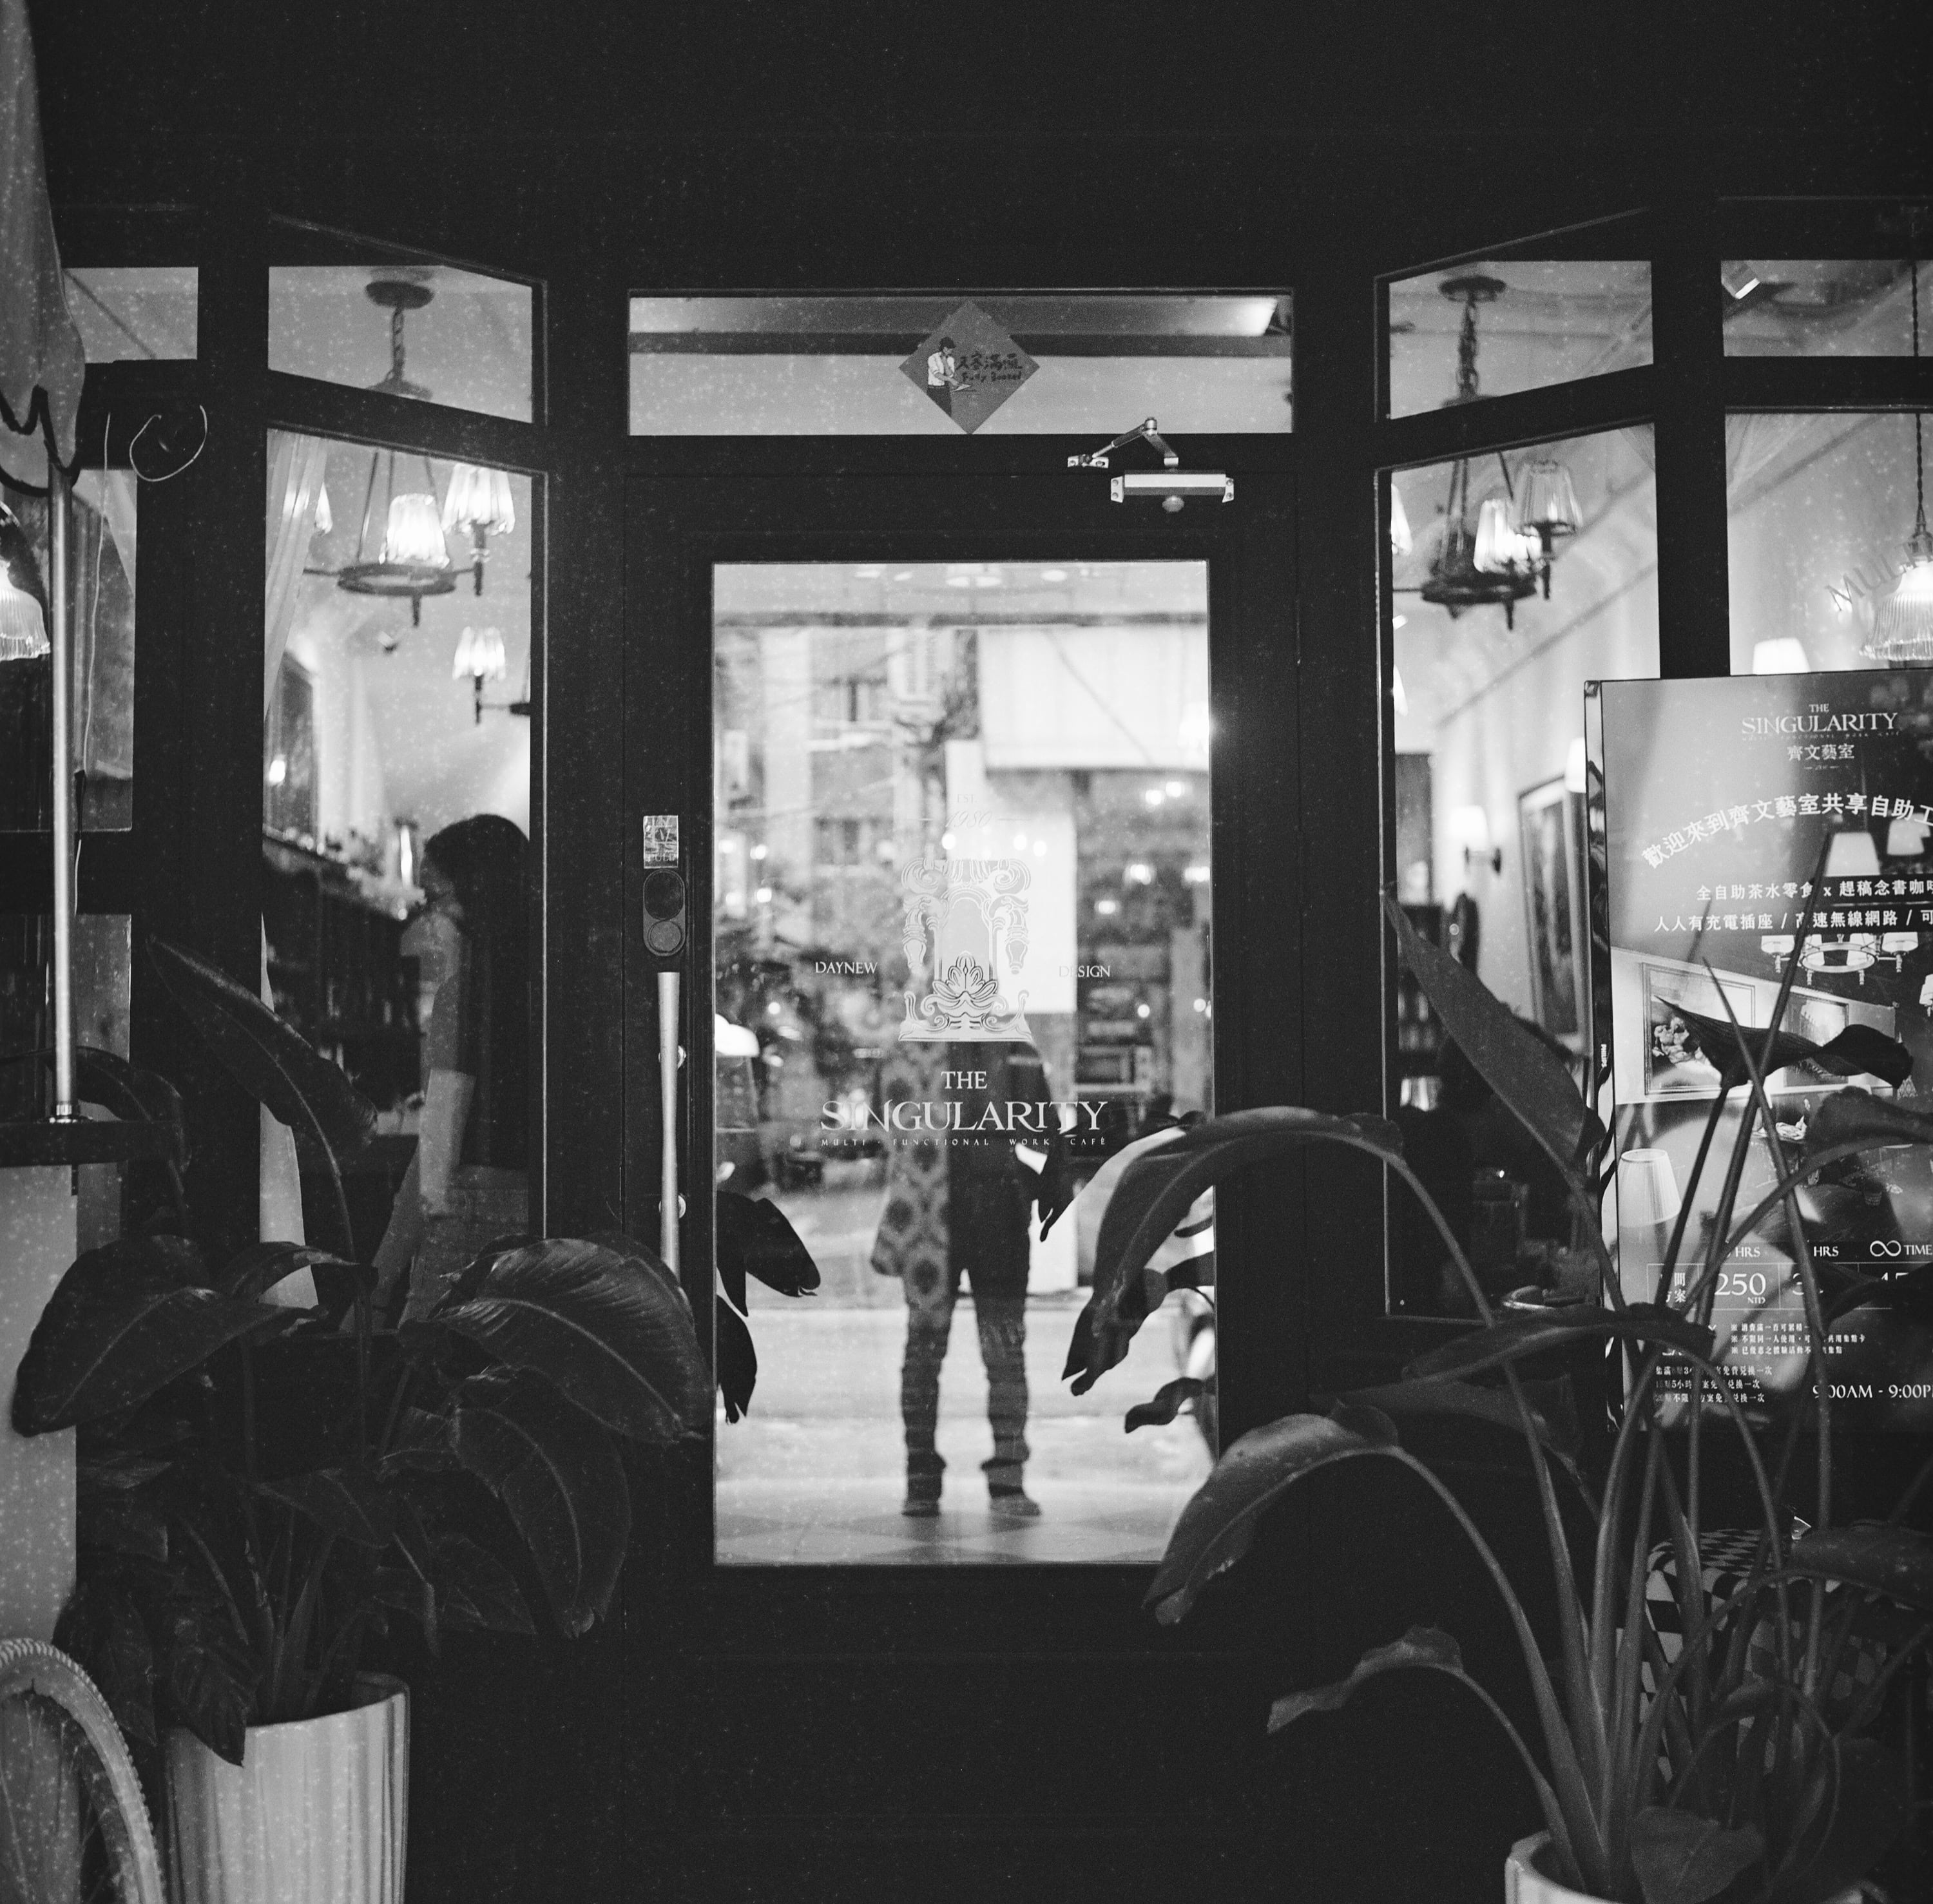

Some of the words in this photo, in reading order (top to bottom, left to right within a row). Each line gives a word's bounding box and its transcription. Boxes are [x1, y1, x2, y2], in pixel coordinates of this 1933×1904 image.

[1809, 703, 1829, 713] THE
[1742, 712, 1898, 735] SINGULARITY
[1787, 743, 1855, 761] 齊文藝室
[945, 809, 993, 829] 1980
[1696, 881, 1814, 901] 全自助茶水零食
[1654, 912, 1773, 932] 人人有充電插座
[815, 961, 878, 975] DAYNEW
[1059, 965, 1111, 978] DESIGN
[941, 1071, 988, 1089] THE
[820, 1099, 1108, 1135] SINGULARITY
[1735, 1246, 1761, 1258] HRS
[1813, 1245, 1840, 1257] HRS
[1903, 1244, 1933, 1256] TIME
[1714, 1272, 1767, 1296] 250
[1813, 1384, 1873, 1399] 900AM
[1888, 1384, 1933, 1399] 9:00P
